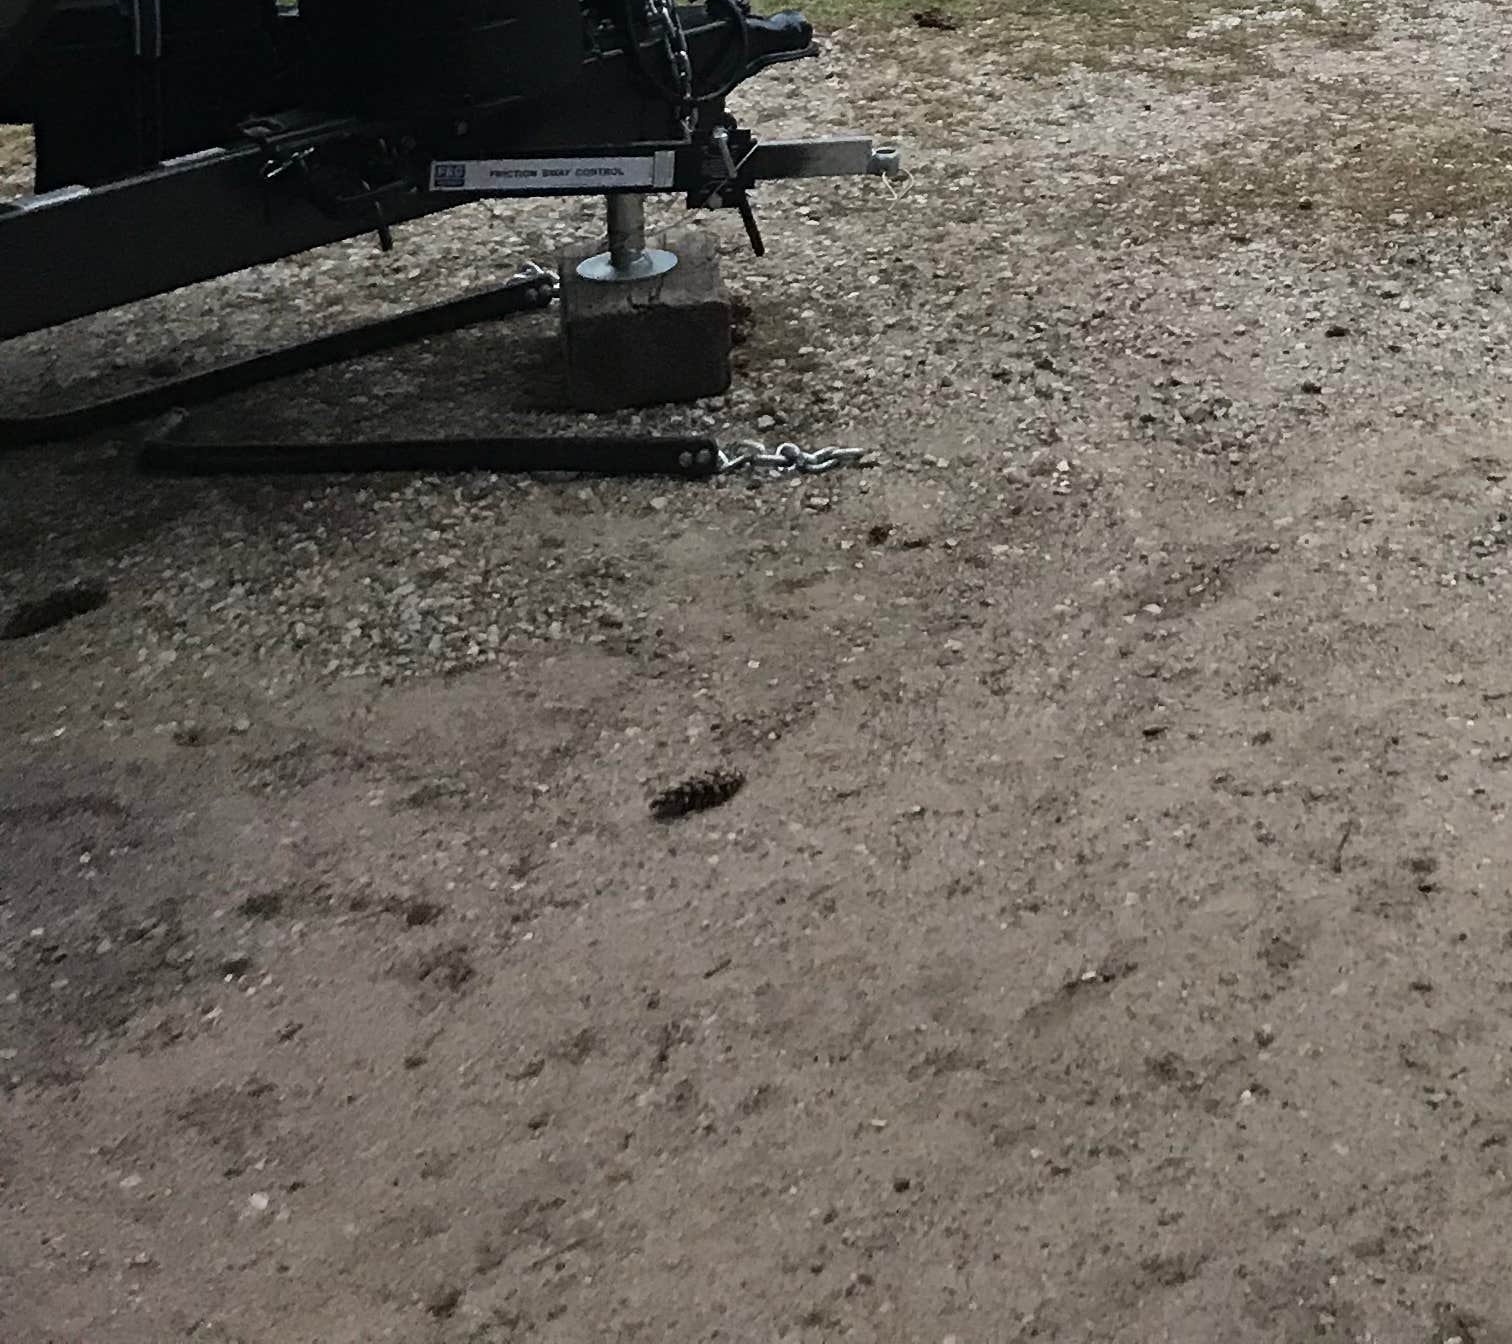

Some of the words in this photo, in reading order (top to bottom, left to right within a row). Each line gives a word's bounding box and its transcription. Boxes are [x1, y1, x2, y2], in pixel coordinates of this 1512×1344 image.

[489, 169, 537, 178] FRICTION
[542, 168, 571, 177] SWAY
[574, 167, 625, 176] CONTROL
